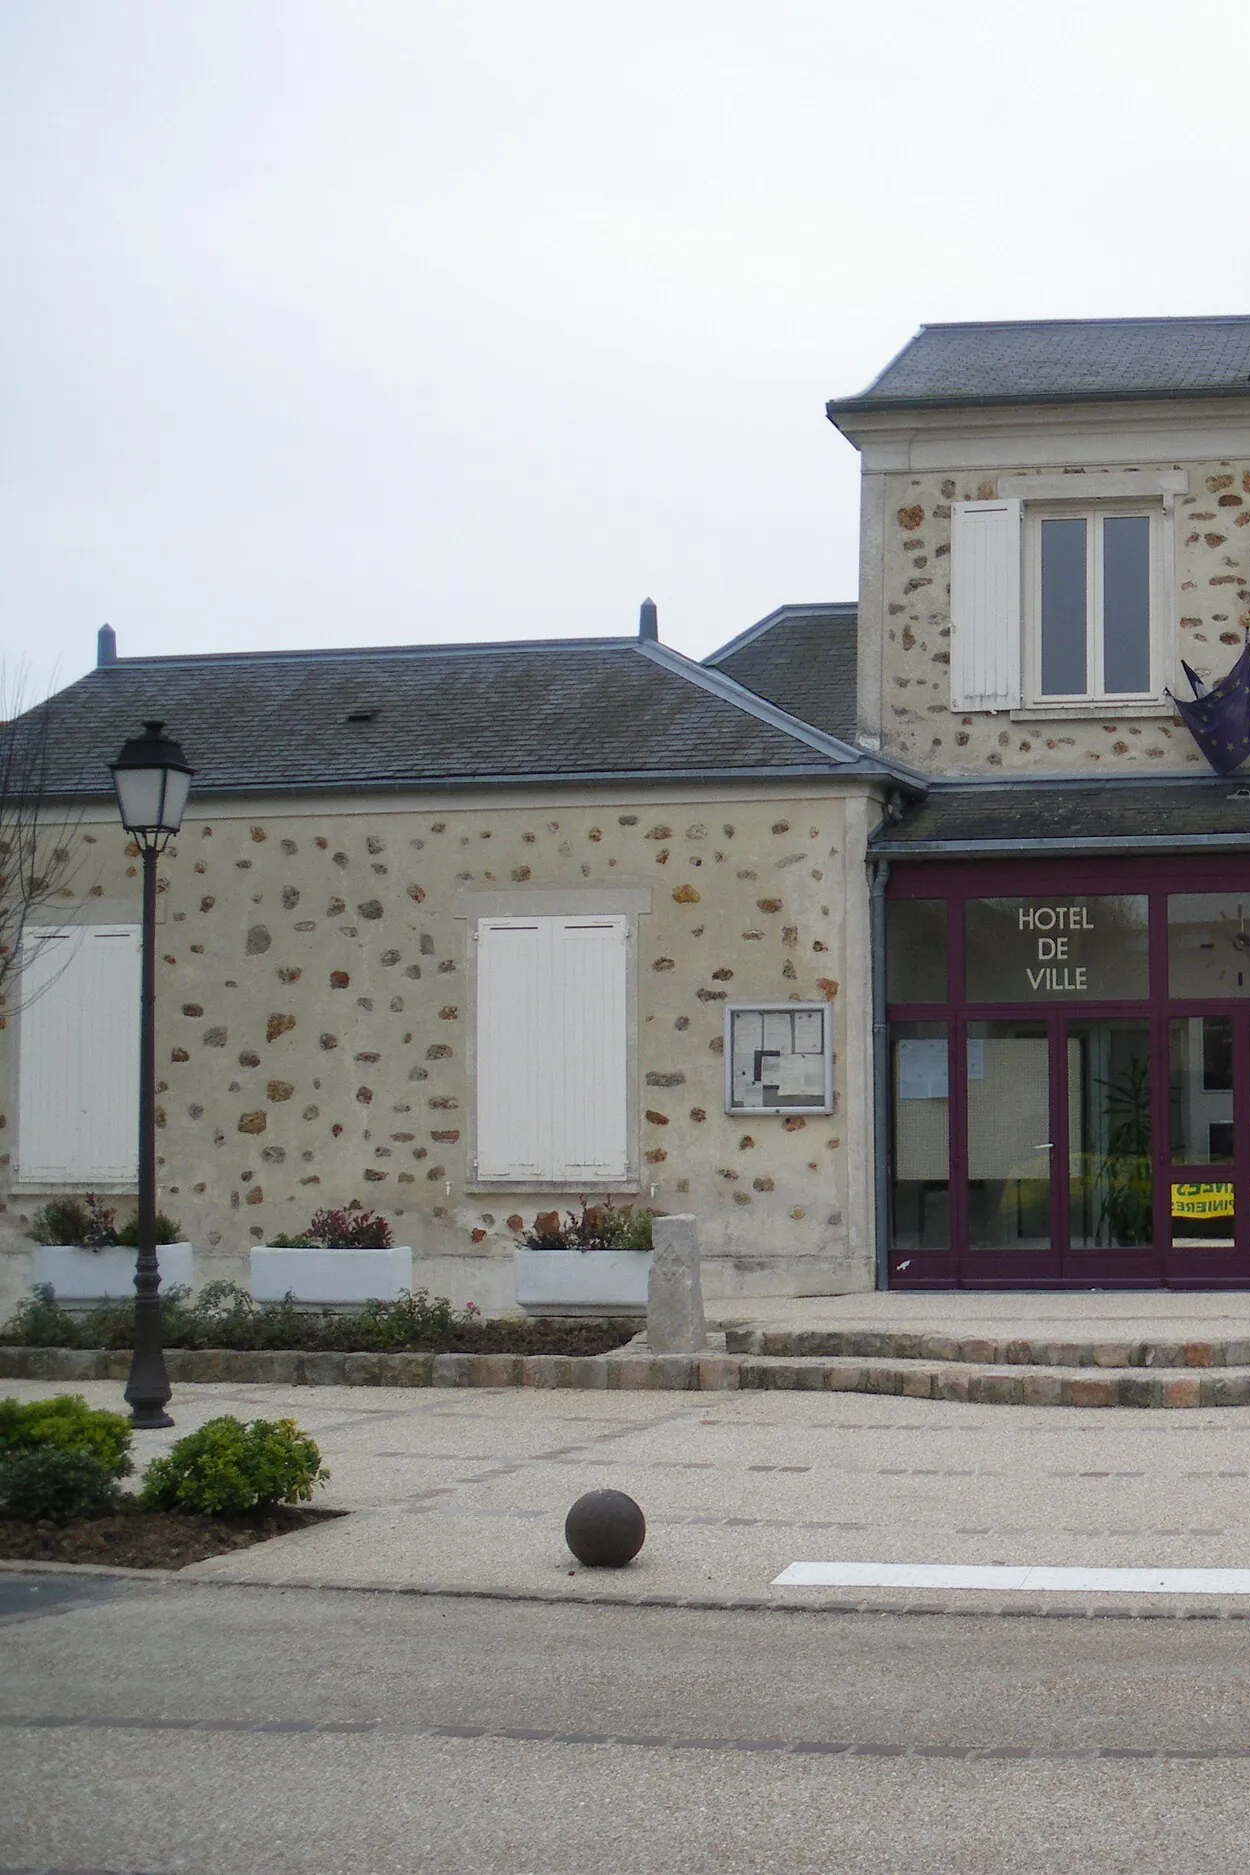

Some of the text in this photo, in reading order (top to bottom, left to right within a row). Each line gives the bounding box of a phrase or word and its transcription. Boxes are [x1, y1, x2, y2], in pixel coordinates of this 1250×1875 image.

[1019, 907, 1094, 930] HOTEL
[1038, 937, 1068, 960] DE
[1026, 967, 1087, 990] VILLE
